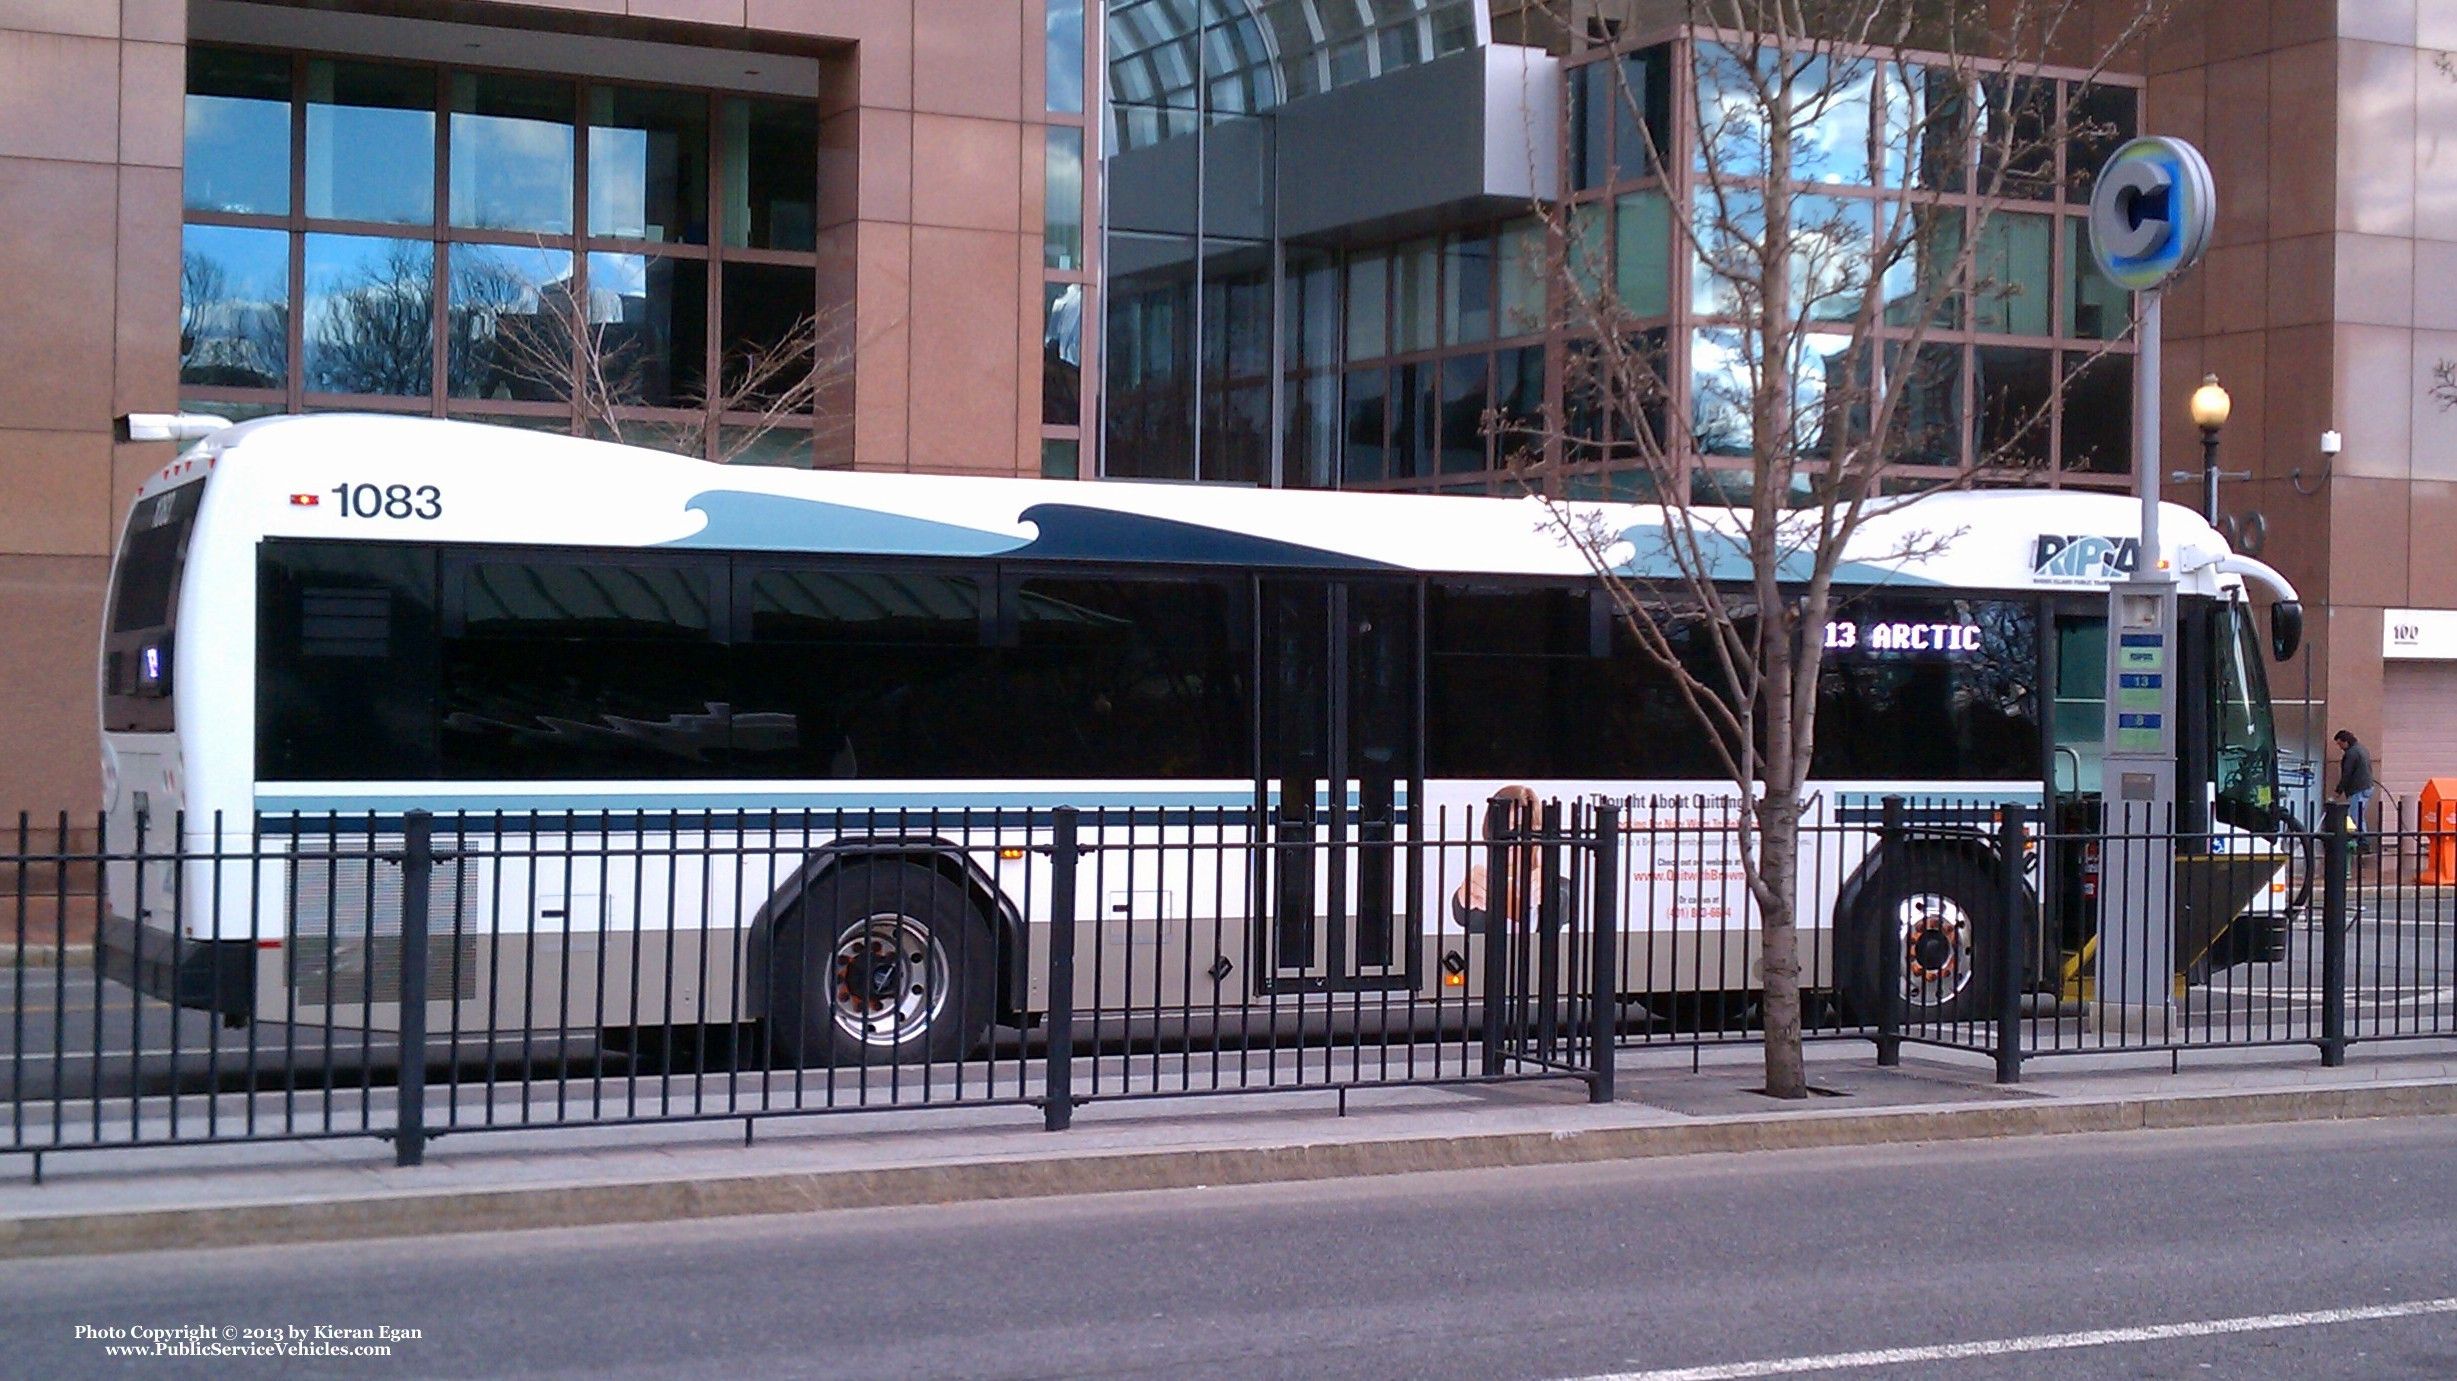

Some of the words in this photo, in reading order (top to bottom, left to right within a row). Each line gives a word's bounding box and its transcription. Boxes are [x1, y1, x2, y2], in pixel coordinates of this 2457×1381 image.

[2096, 160, 2172, 260] C
[331, 482, 443, 521] 1083
[2034, 533, 2141, 577] RIPTA
[1824, 621, 1857, 648] 13
[1872, 623, 1981, 650] ARCTIC
[2394, 624, 2419, 640] 100
[2134, 676, 2149, 687] 13
